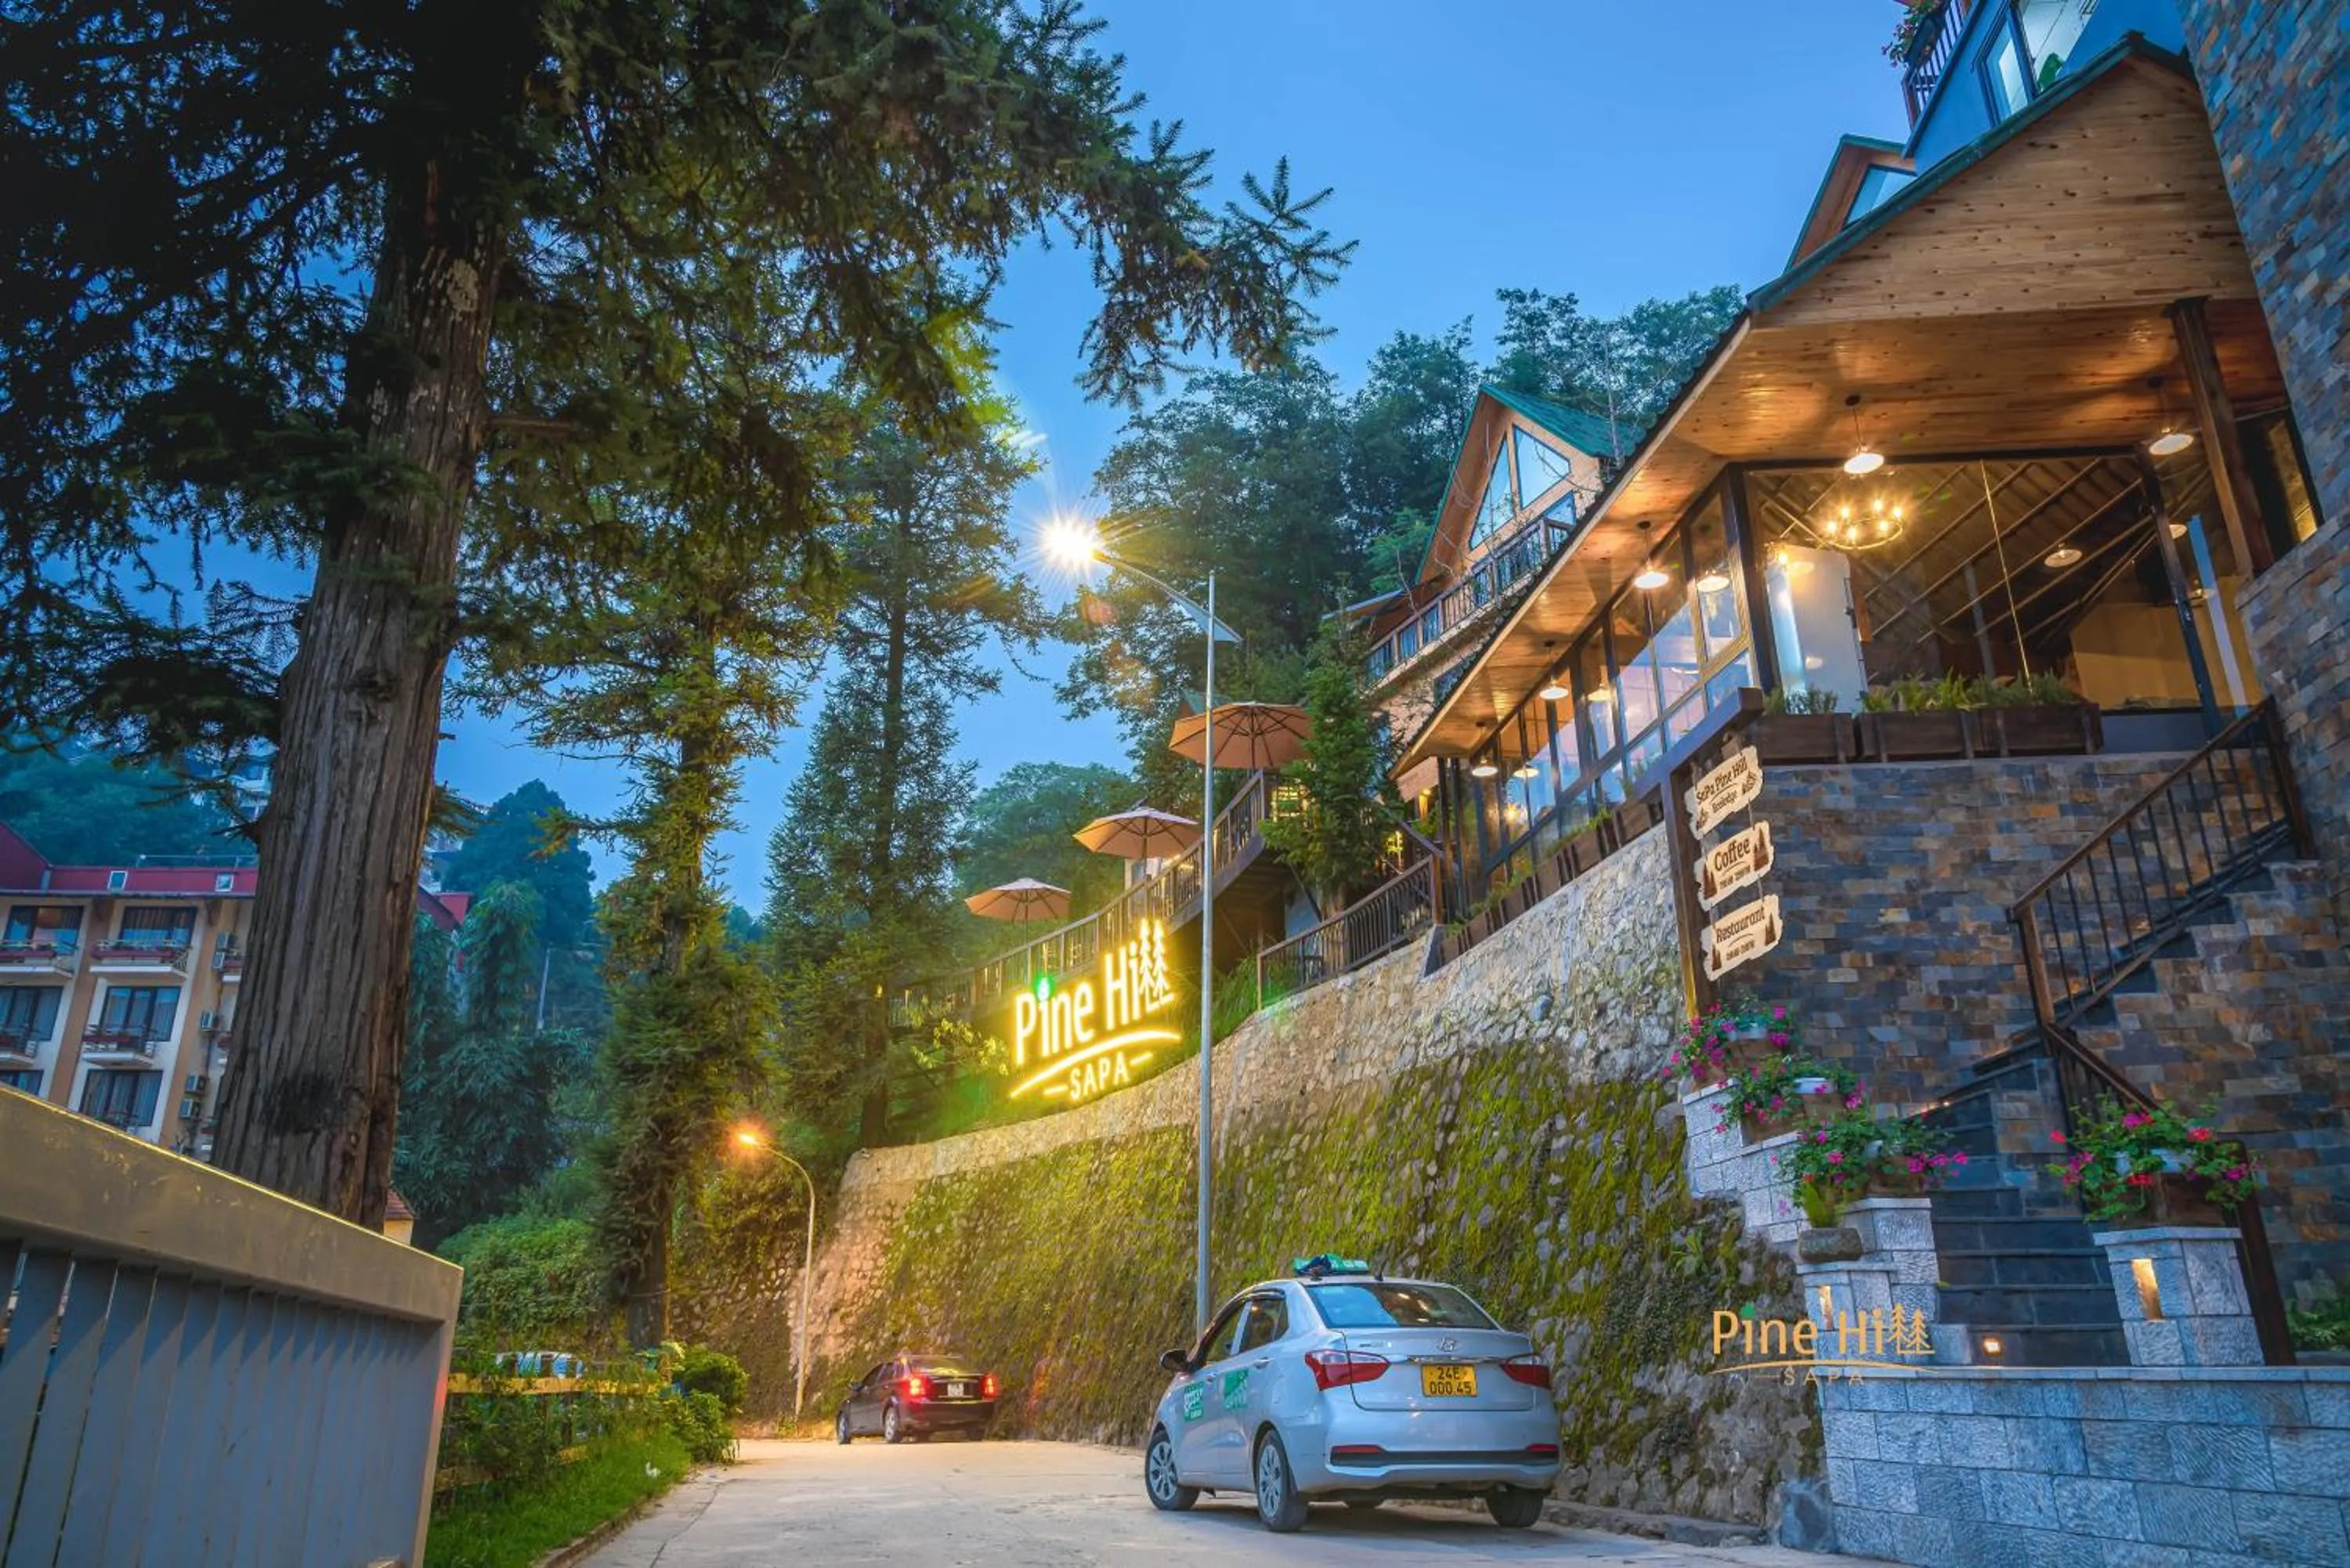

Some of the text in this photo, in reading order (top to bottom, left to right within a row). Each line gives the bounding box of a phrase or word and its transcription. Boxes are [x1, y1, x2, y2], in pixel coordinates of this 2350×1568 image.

[1716, 770, 1732, 792] Pine
[1732, 756, 1748, 778] Hill
[1715, 838, 1750, 871] Coffee
[1716, 905, 1765, 943] Restaurant
[1016, 977, 1095, 1065] Pine
[1070, 1052, 1130, 1100] SAPA
[1430, 1381, 1472, 1394] 000.45
[1437, 1367, 1461, 1380] 24E
